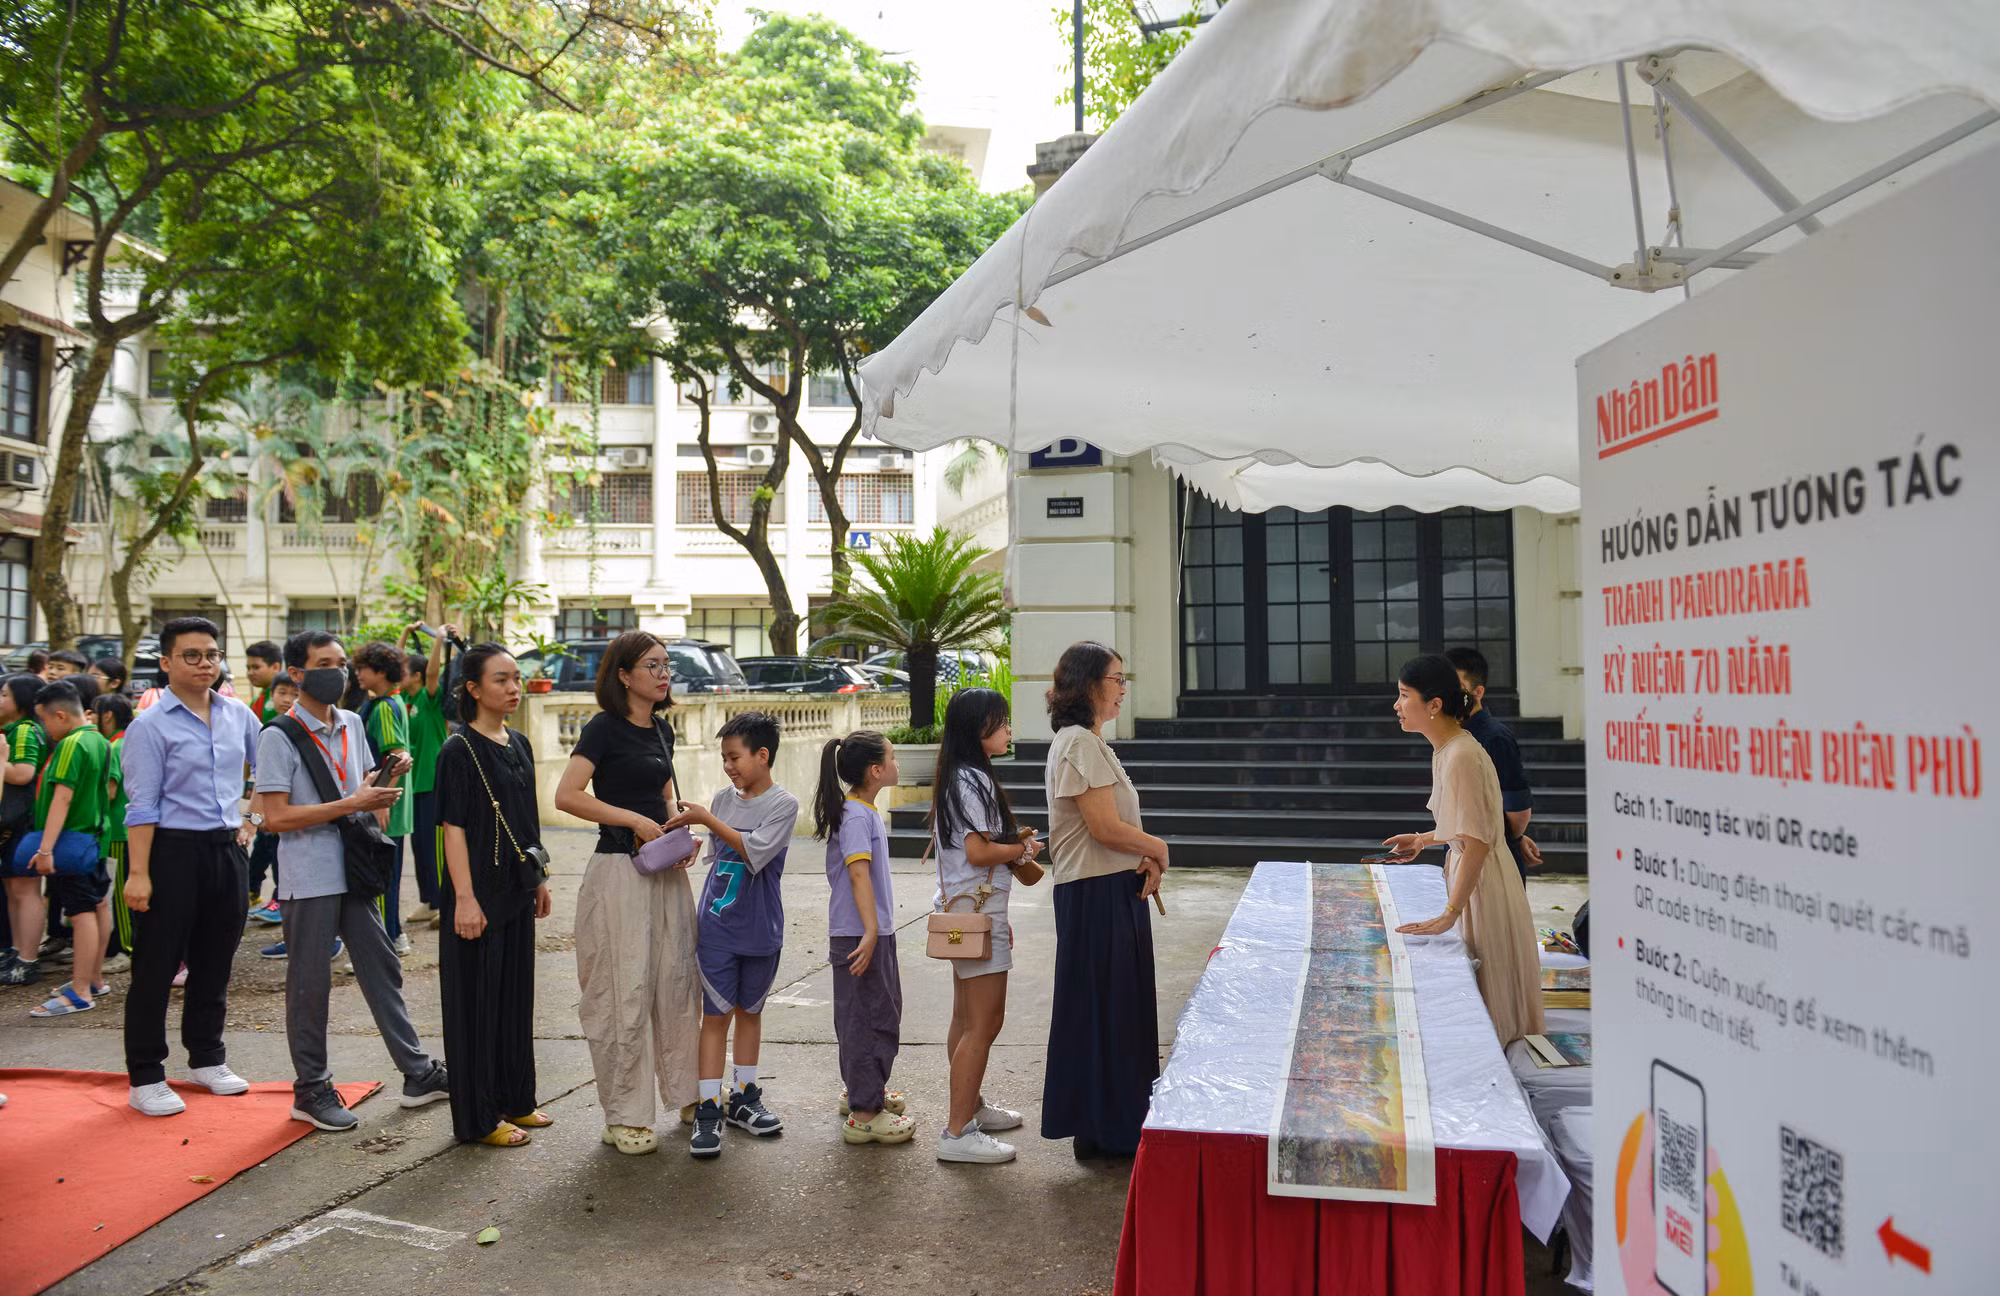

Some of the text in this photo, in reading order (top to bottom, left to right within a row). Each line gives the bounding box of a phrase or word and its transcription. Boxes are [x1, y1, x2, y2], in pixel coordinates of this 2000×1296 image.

[1597, 352, 1719, 448] Nhân Dân
[1602, 433, 1963, 564] HƯỚNG DẪN TƯƠNG TÁC
[853, 533, 869, 547] A
[1602, 556, 1811, 627] TRANH PANORAMA
[1632, 642, 1686, 701] NIỆM
[1691, 648, 1720, 694] 70
[1727, 635, 1791, 695] NĂM
[1605, 706, 1661, 766] CHIẾN
[1666, 706, 1740, 774] THẮNG
[1748, 718, 1812, 788] ĐIỆN
[1822, 720, 1895, 791] BIÊN
[1614, 791, 1645, 819] Cách
[1650, 796, 1662, 822] 1:
[1716, 807, 1740, 836] tác
[1776, 817, 1803, 848] QR
[1809, 826, 1858, 857] code
[709, 860, 746, 917] 7
[1635, 884, 1778, 951] QR code trên tranh
[1672, 856, 1685, 883] 1:
[1689, 861, 1729, 901] Dùng
[1734, 873, 1770, 907] điện
[1775, 881, 1822, 922] thoại
[1828, 899, 1875, 933] quét
[1882, 908, 1922, 946] các
[1930, 924, 1971, 958] mã
[1636, 977, 1674, 1019] thông
[1678, 994, 1697, 1023] tin
[1701, 1005, 1724, 1035] chi
[1674, 952, 1687, 980] 2:
[1691, 958, 1731, 997] Cuộn
[1736, 980, 1788, 1027] xuống
[1821, 1014, 1867, 1051] xem
[1872, 1027, 1935, 1077] thêm
[1665, 1204, 1694, 1234] SCAN
